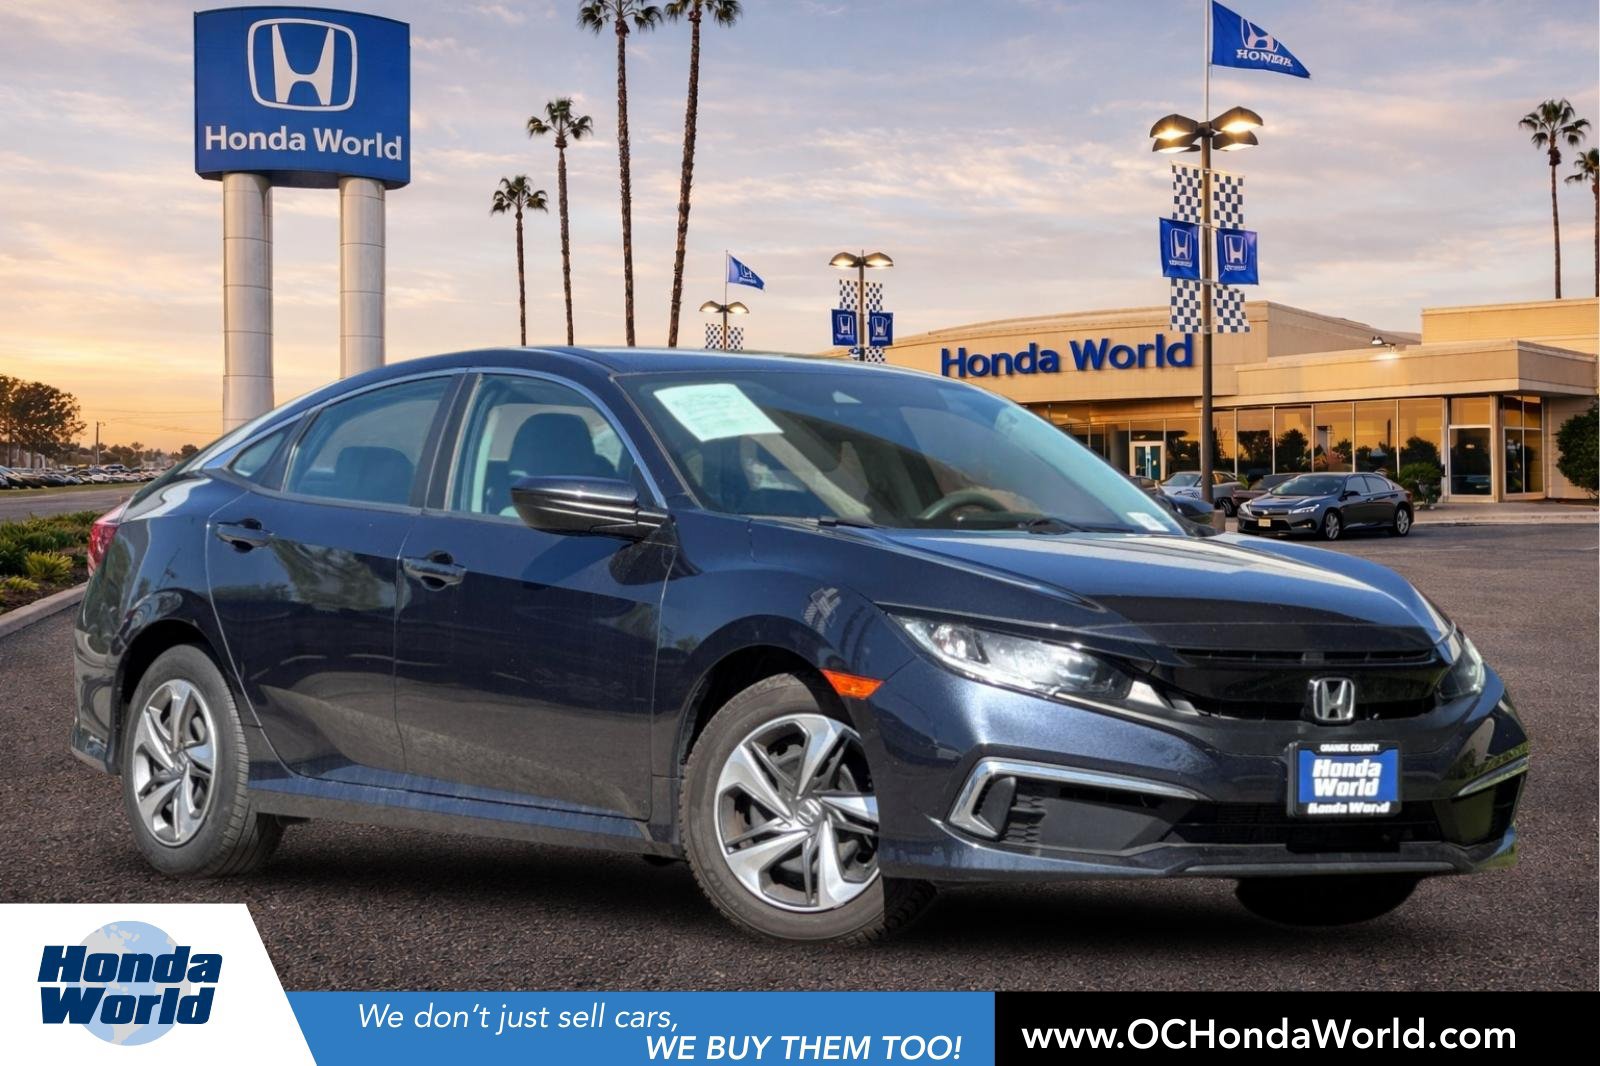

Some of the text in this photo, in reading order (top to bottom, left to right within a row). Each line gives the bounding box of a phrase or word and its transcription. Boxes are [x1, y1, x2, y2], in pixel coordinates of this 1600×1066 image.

[205, 126, 402, 161] Honda World
[941, 333, 1194, 378] Honda World
[1320, 743, 1379, 752] ORANGE COUNTY
[1312, 758, 1382, 778] Honda
[1313, 778, 1380, 797] World
[1307, 801, 1347, 814] Honda
